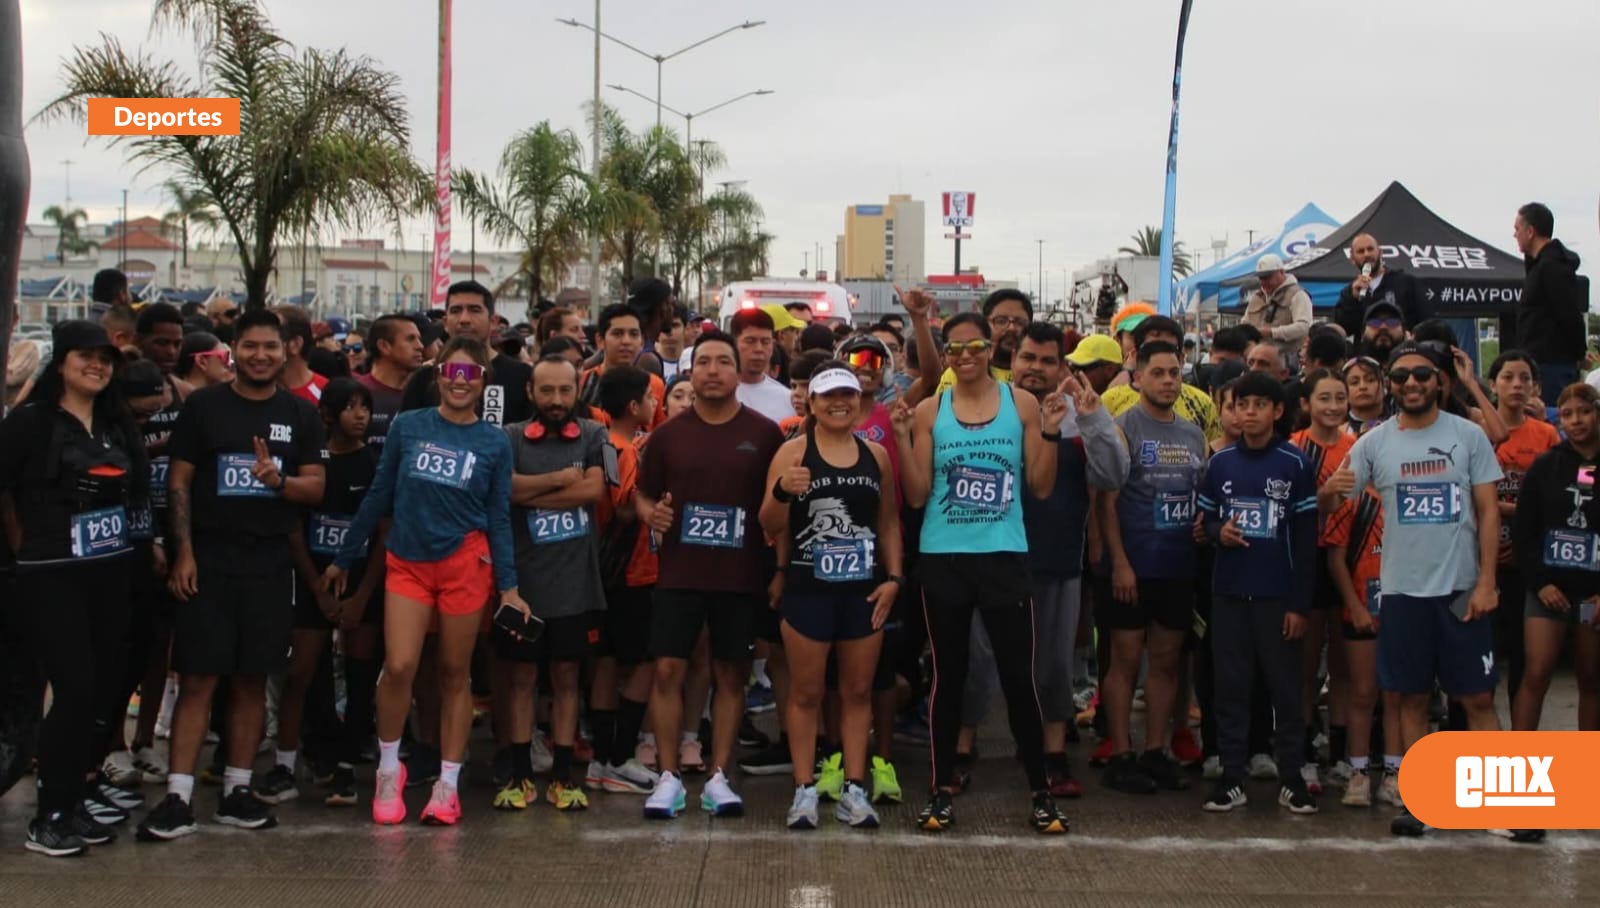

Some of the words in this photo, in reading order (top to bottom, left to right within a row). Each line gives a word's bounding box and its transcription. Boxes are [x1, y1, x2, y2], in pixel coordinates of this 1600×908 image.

[948, 217, 971, 225] KFC
[486, 388, 502, 424] adid
[416, 452, 457, 477] 033
[837, 476, 880, 492] POTRO
[956, 479, 996, 502] 065
[1160, 502, 1189, 520] 144
[1403, 497, 1445, 517] 245
[87, 515, 122, 540] 034
[535, 512, 575, 537] 276
[688, 517, 728, 538] 224
[1550, 541, 1587, 562] 163
[820, 552, 860, 574] 072
